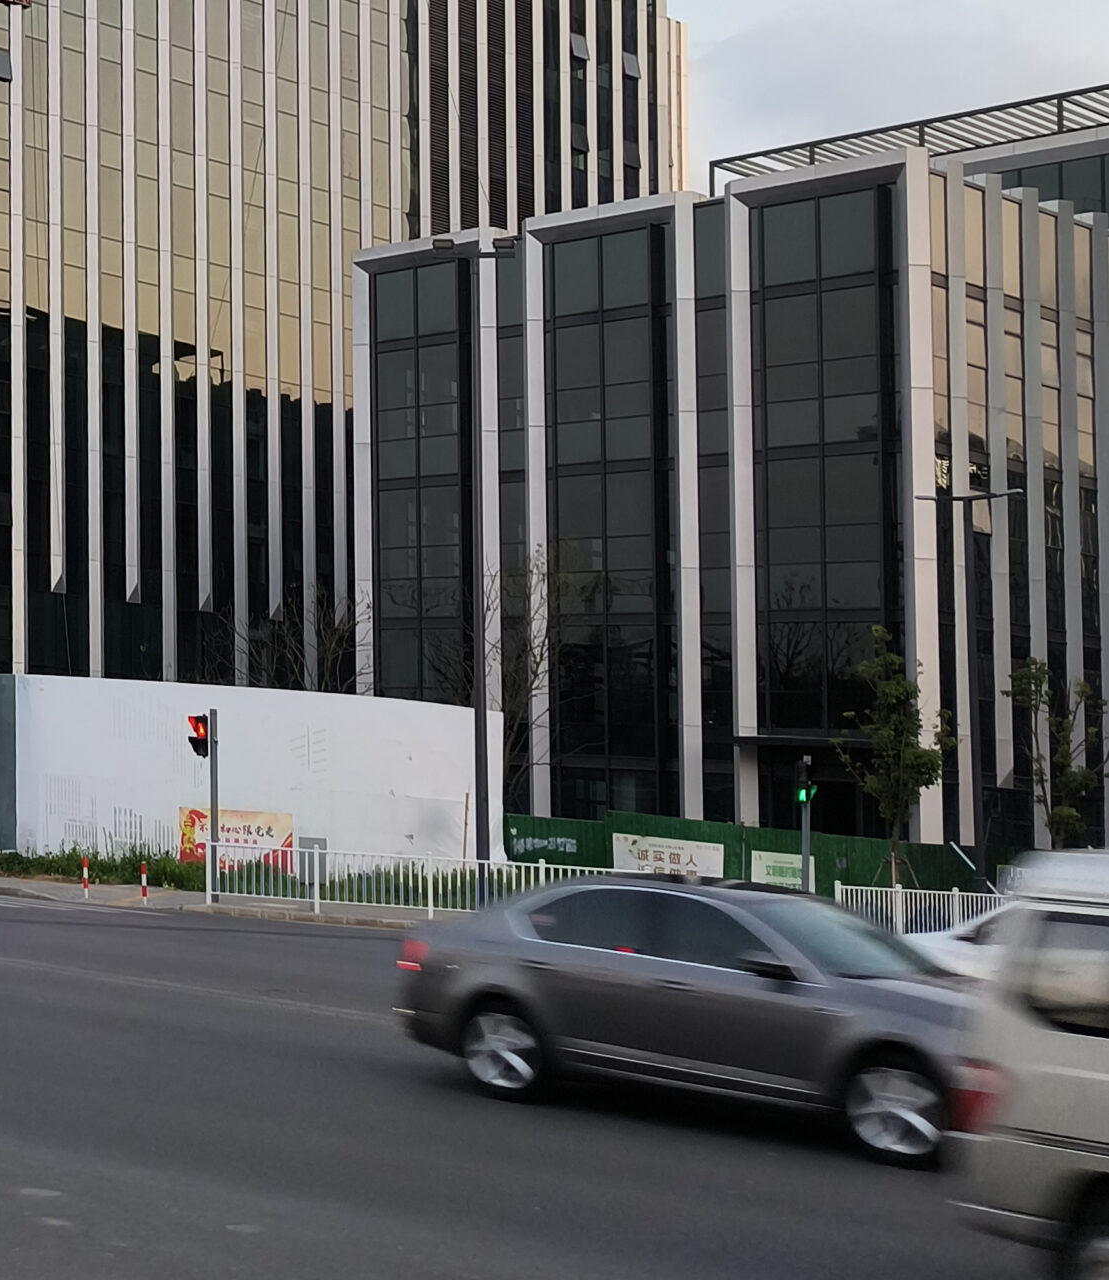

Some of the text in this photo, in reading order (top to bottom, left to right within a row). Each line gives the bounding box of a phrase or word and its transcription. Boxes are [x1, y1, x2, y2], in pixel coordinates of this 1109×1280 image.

[199, 823, 274, 838] 不初心跟党走
[637, 848, 698, 867] 诚实做人
